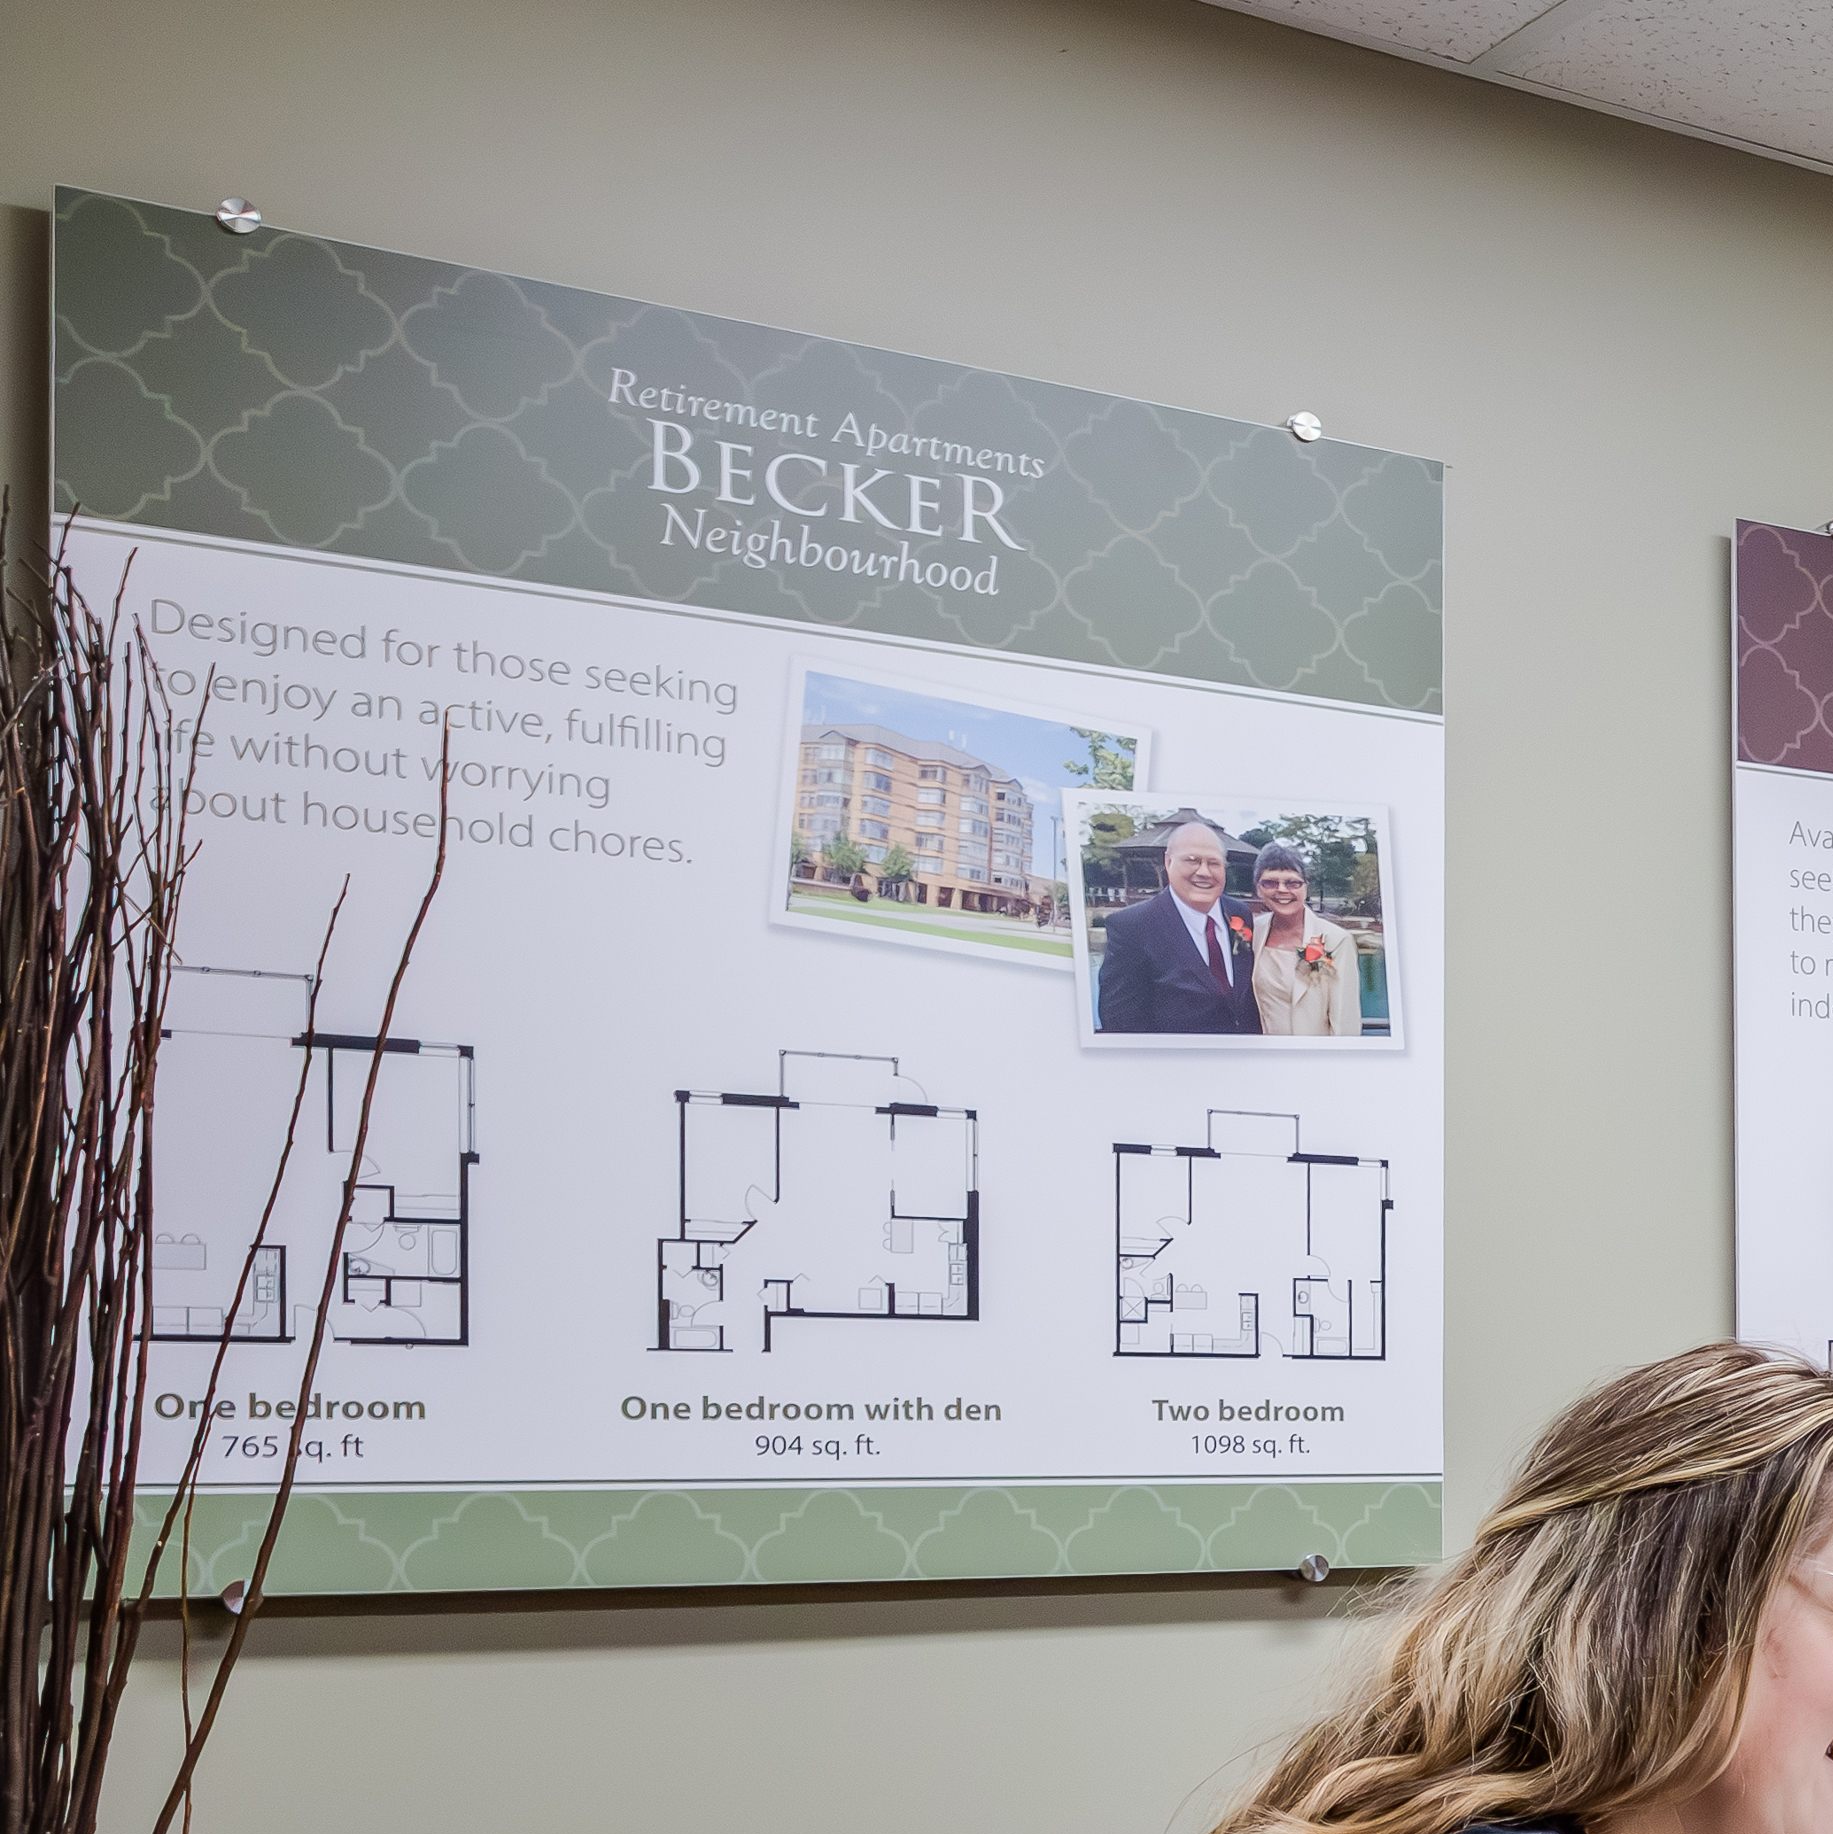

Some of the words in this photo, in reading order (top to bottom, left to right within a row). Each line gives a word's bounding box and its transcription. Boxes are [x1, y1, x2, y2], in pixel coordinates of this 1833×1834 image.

[608, 368, 818, 437] Retirement
[831, 412, 1044, 478] Apartments
[646, 418, 1026, 551] BECKER
[660, 503, 998, 595] Neighbourhood
[151, 599, 366, 659] Designed
[381, 629, 440, 668] for
[452, 640, 571, 685] those
[585, 664, 737, 715] seeking
[212, 654, 337, 721] enjoy
[350, 692, 402, 721] an
[418, 699, 552, 744] active,
[564, 708, 726, 768] fulfilling
[230, 732, 407, 780] without
[421, 757, 610, 809] worrying
[549, 819, 694, 864] chores.
[1790, 951, 1816, 975] to
[249, 1392, 426, 1421] bedroom
[621, 1396, 691, 1420] One
[702, 1396, 854, 1420] bedroom
[864, 1397, 933, 1421] with
[944, 1397, 1001, 1421] den
[1152, 1400, 1209, 1421] Two
[1219, 1399, 1344, 1421] bedroom
[222, 1435, 278, 1459] 765
[755, 1435, 803, 1456] 904
[812, 1440, 847, 1461] sq.
[855, 1434, 880, 1455] ft.
[1192, 1435, 1245, 1454] 1098
[1252, 1440, 1282, 1459] sq.
[1289, 1434, 1310, 1453] ft.
